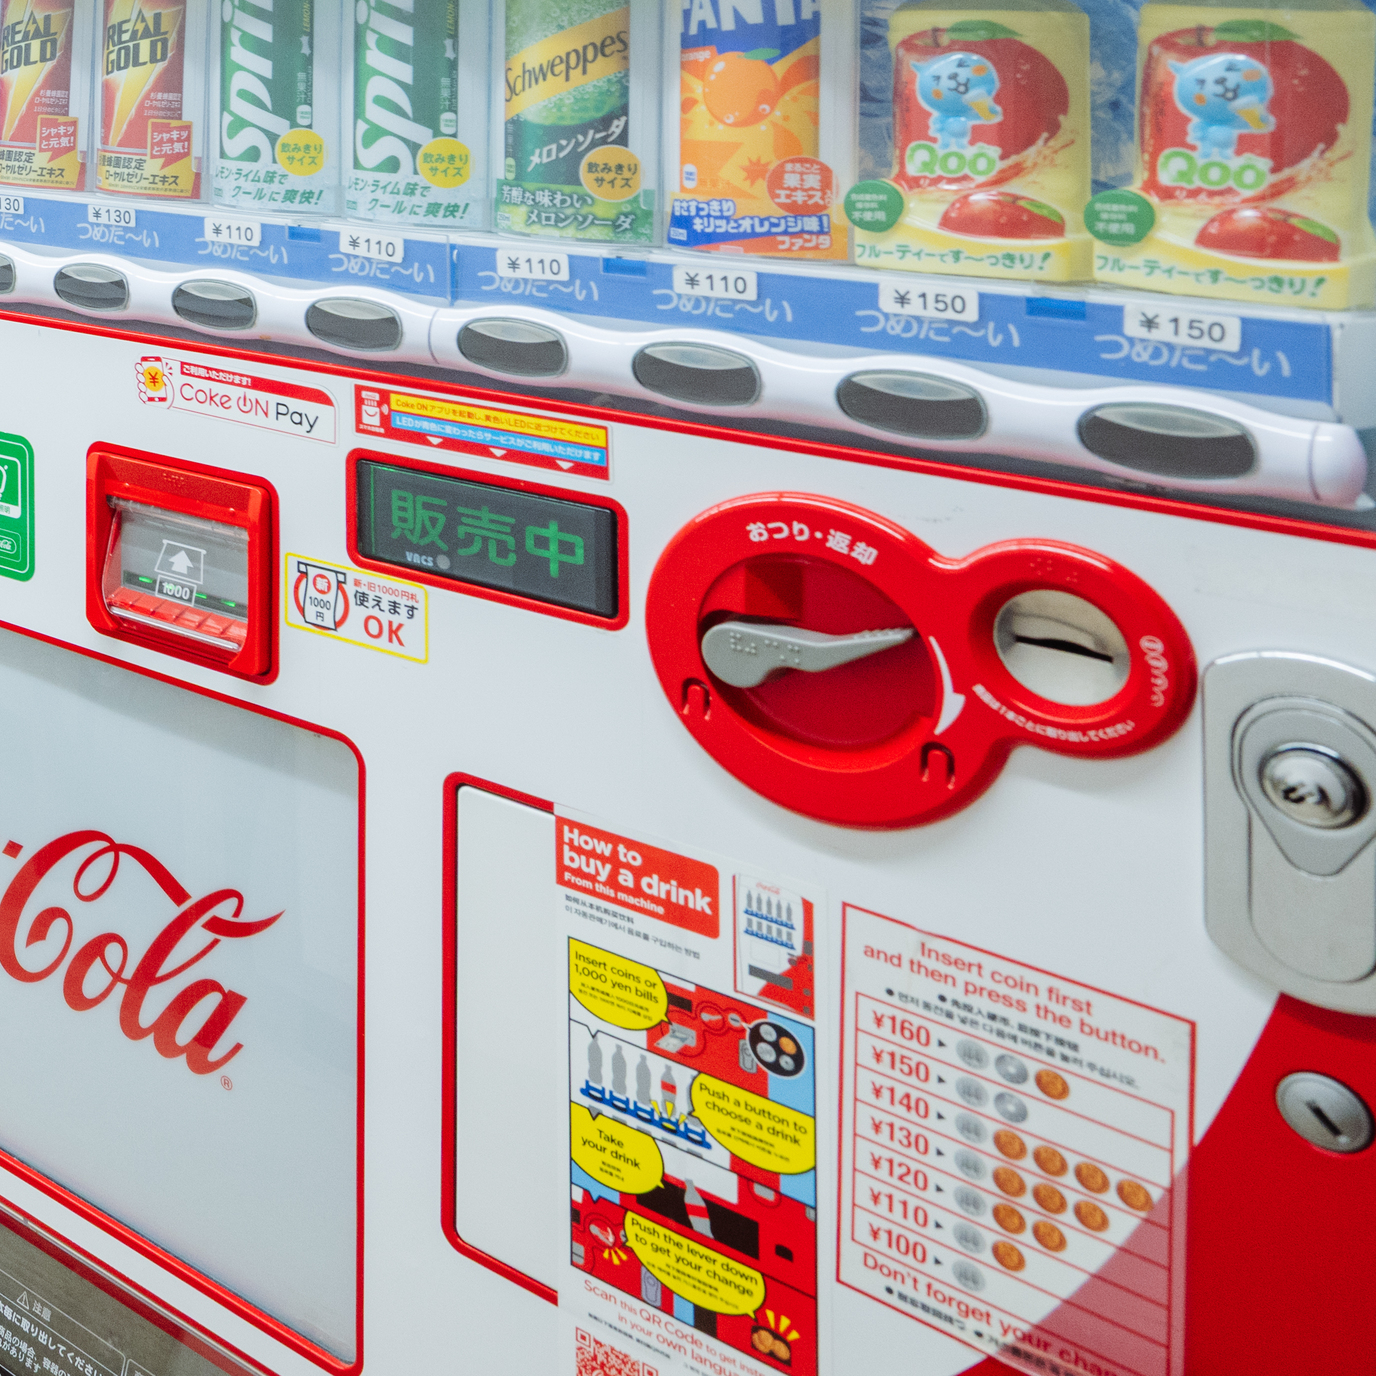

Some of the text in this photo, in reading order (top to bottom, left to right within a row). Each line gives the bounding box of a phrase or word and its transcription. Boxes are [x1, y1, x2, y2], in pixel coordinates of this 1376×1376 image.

[106, 7, 170, 51] REAL
[106, 36, 170, 75] GOLD
[504, 28, 629, 105] Schweppes
[422, 151, 470, 166] 飲みきり
[526, 114, 628, 173] メロンソーダ
[428, 165, 464, 179] サイズ
[782, 173, 822, 190] 果実
[1157, 148, 1273, 192] Qoo
[348, 233, 396, 258] ¥110
[1139, 313, 1227, 345] ¥150
[180, 361, 252, 387] ご利用いただけます!
[180, 381, 233, 414] Coke
[274, 402, 320, 433] Pay
[396, 398, 600, 442] Coke ON アプリを起動し、黄色いLEDに近づけてください
[395, 415, 602, 462] LEDが青色に変わったらサービスがご利用いただけます
[390, 488, 586, 579] 販売中
[745, 520, 879, 567] おつり・返却
[161, 582, 191, 601] 1000
[352, 578, 420, 604] 新・旧1000円札
[352, 589, 420, 620] 使えます
[362, 615, 407, 648] OK
[562, 825, 642, 867] How to
[562, 844, 713, 916] buy a drink
[564, 871, 666, 916] From this machine
[919, 941, 1094, 1017] Insert coin first
[862, 945, 1167, 1064] and then press the button.
[871, 1009, 932, 1048] ¥160
[581, 1136, 642, 1171] your drink
[596, 1128, 625, 1149] Take
[868, 1222, 927, 1265] ¥100
[862, 1251, 919, 1293] Don't
[925, 1282, 993, 1327] forget
